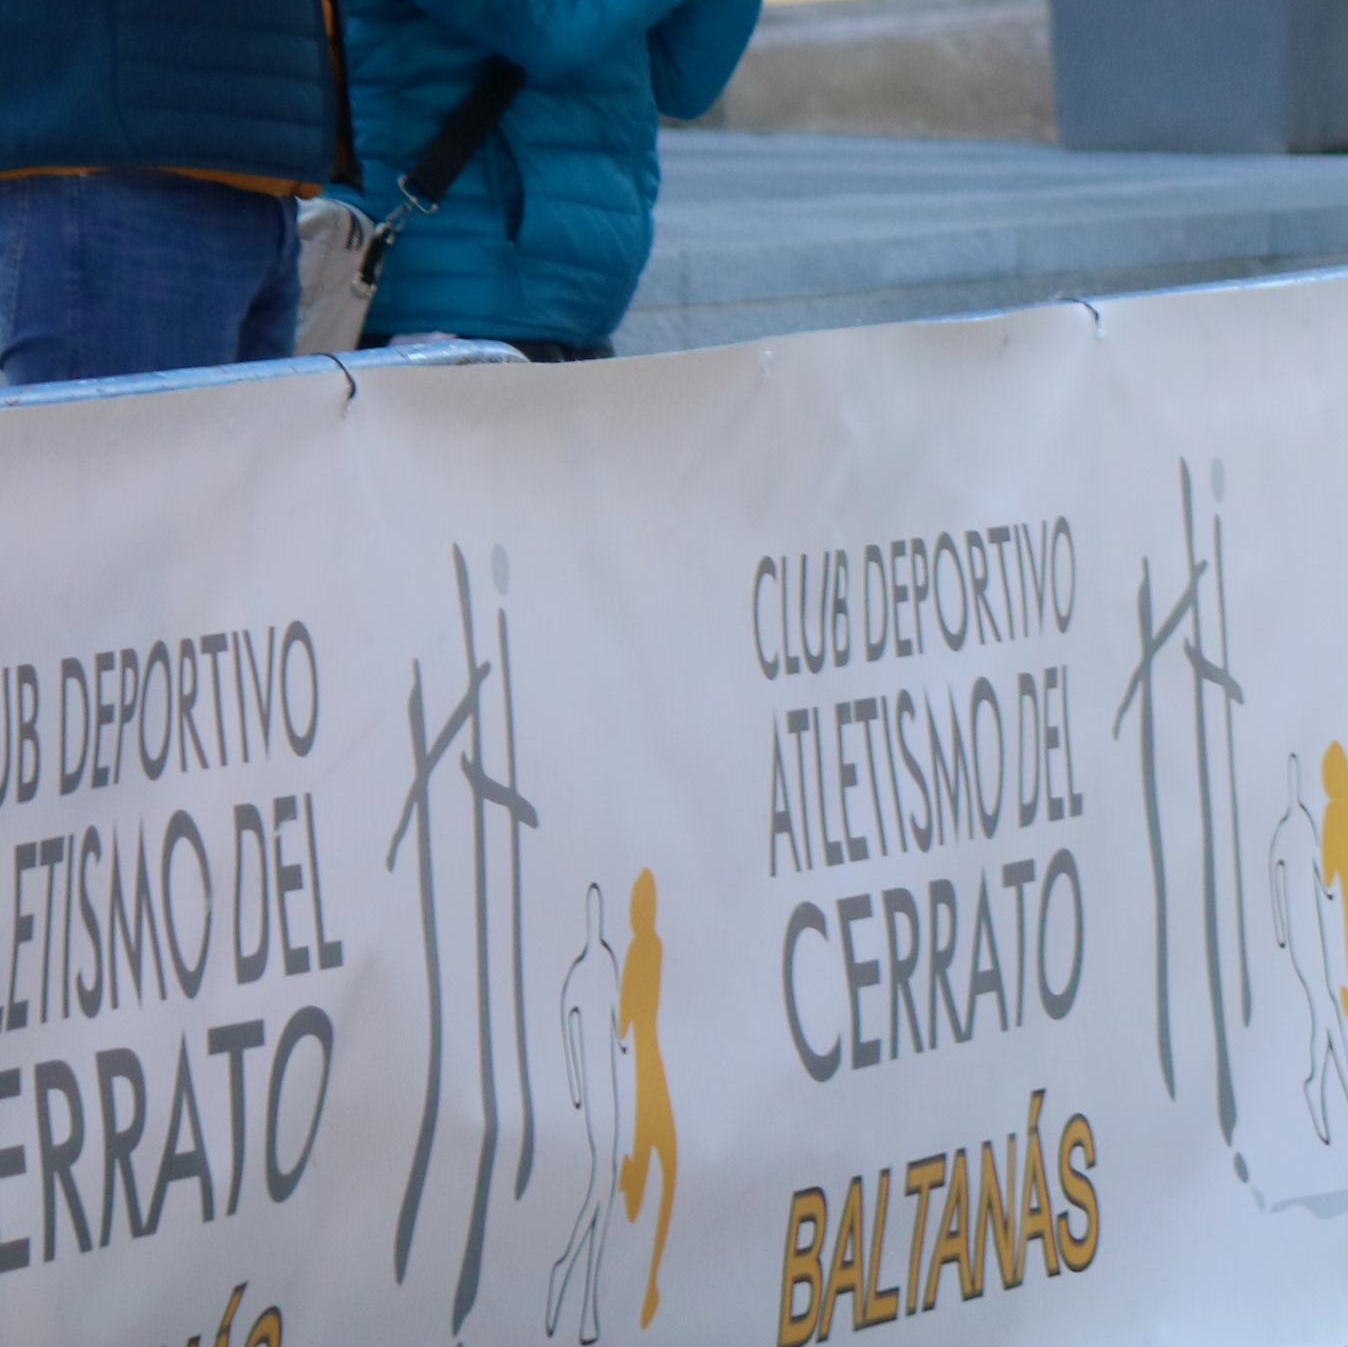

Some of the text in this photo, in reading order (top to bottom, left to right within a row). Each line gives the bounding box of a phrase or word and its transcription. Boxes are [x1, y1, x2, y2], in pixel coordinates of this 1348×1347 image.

[60, 619, 319, 796] DEPORTIVO
[753, 515, 1076, 681] CLUB DEPORTIVO
[770, 664, 1083, 877] ATLETISMO DEL
[0, 792, 344, 1033] ETISMO DEL
[782, 847, 1084, 1083] CERRATO
[777, 1087, 1100, 1347] BALTANÁS
